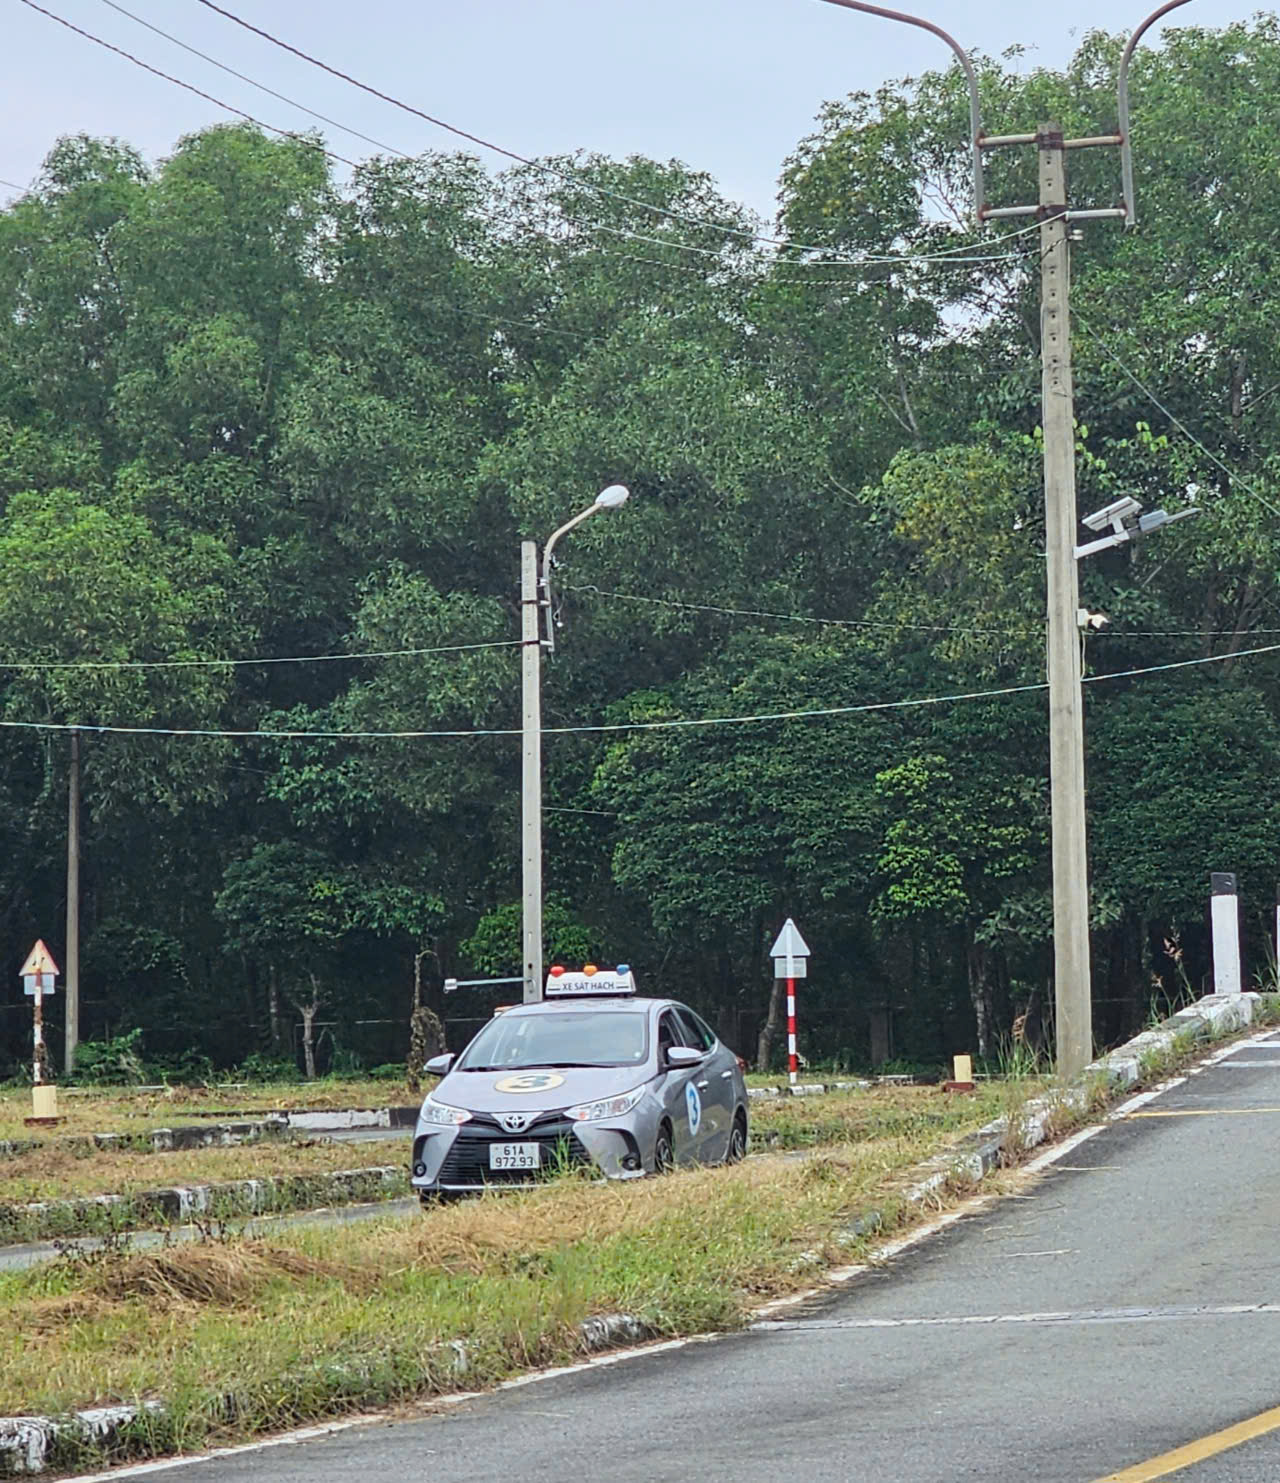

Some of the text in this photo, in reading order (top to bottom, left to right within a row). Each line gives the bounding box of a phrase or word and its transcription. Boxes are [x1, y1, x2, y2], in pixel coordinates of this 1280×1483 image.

[562, 983, 572, 991] XE
[508, 1075, 551, 1089] 3
[690, 1088, 698, 1125] 3
[503, 1145, 524, 1155] 61A
[495, 1156, 534, 1167] 972.93
